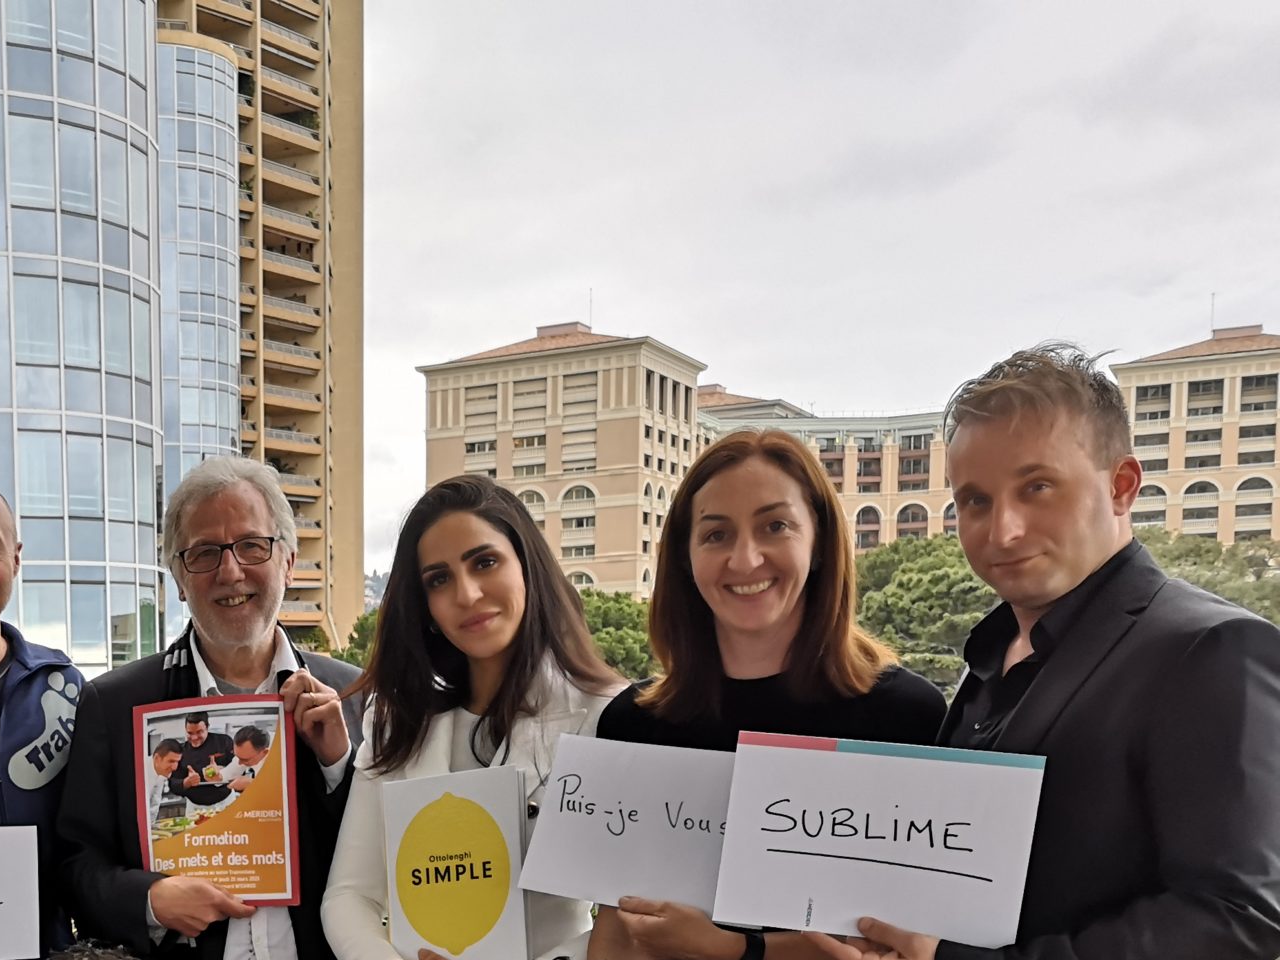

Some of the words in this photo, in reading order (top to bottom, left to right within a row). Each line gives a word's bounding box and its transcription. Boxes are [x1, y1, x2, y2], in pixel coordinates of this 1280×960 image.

[184, 831, 249, 848] Formation
[154, 858, 176, 872] Des
[178, 853, 208, 868] mets
[211, 851, 223, 866] et
[227, 851, 249, 865] des
[252, 850, 285, 865] mots
[428, 851, 472, 863] Ottolenghi
[411, 861, 493, 886] SIMPLE
